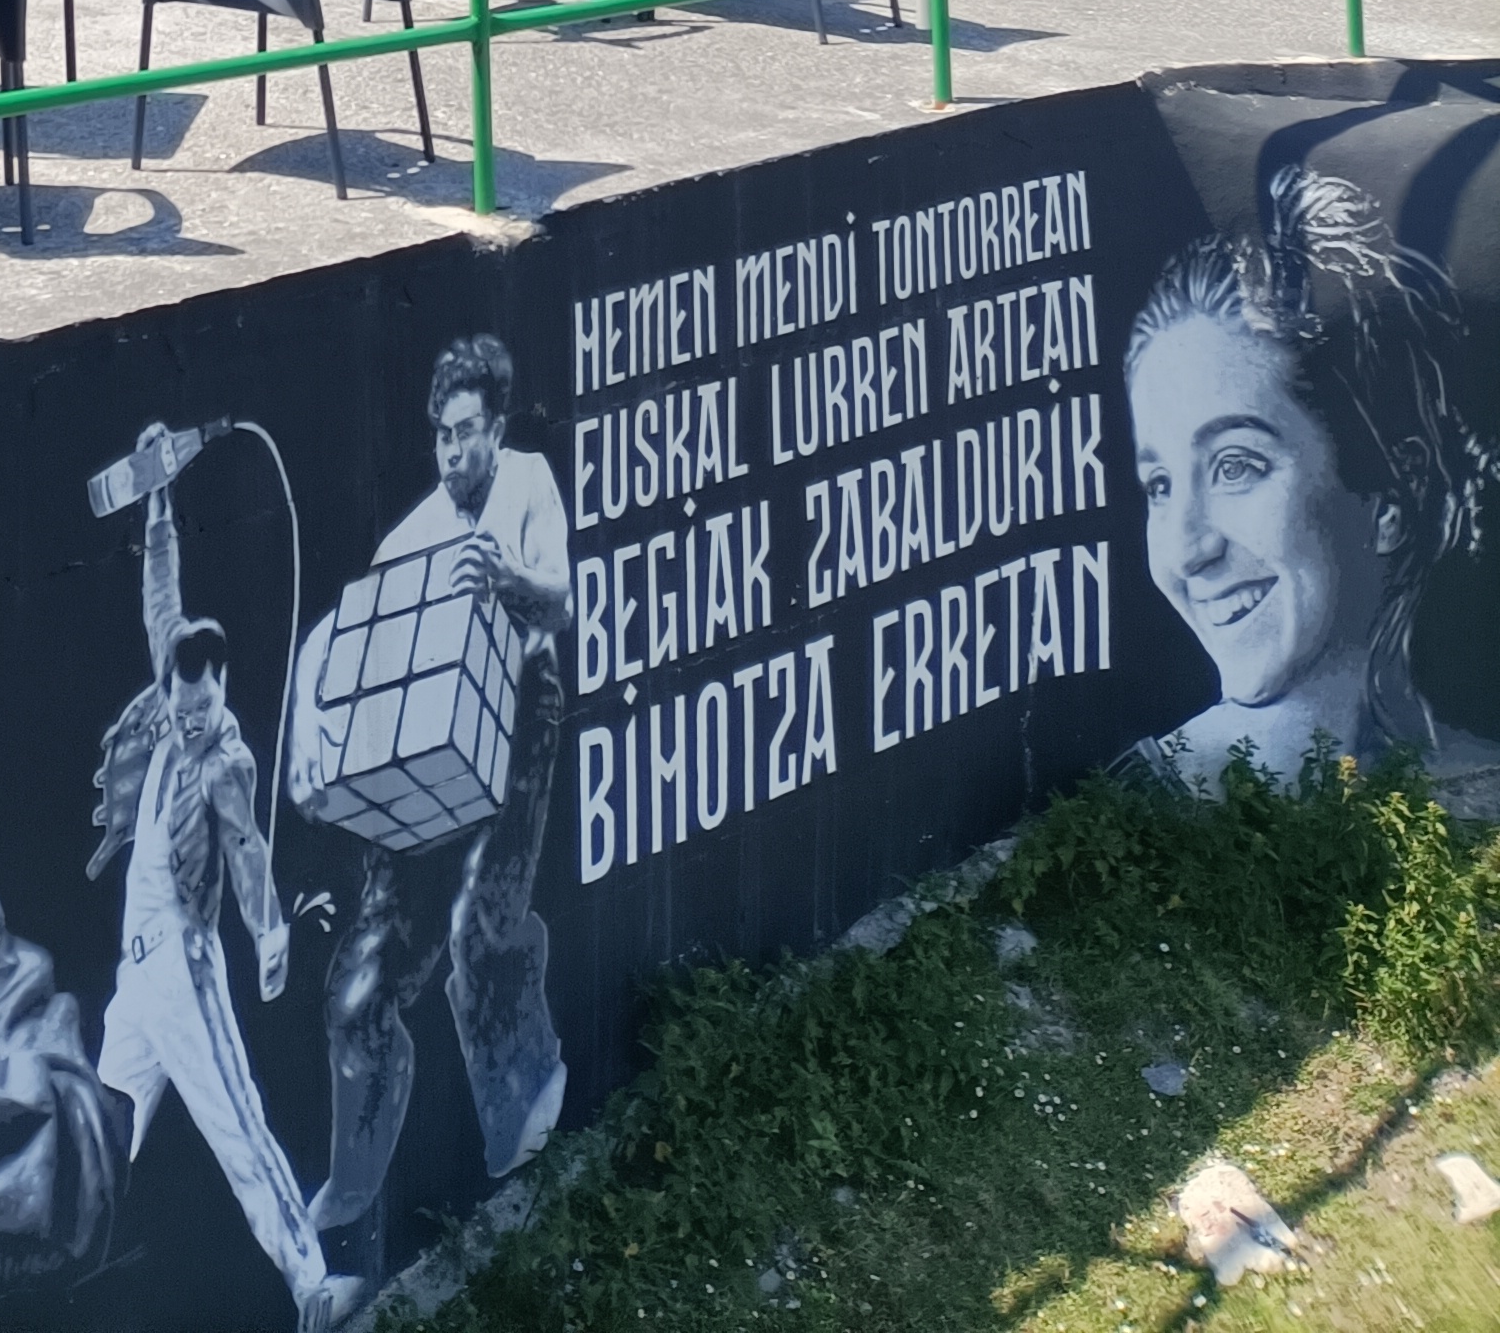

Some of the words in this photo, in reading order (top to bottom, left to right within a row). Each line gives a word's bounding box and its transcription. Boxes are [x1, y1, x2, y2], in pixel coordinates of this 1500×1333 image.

[575, 264, 717, 396] HEMEN
[735, 211, 857, 348] MENDI
[871, 170, 1092, 306] TONTORREAN
[575, 376, 749, 531] EUSKAL
[771, 318, 929, 465] LURREN
[947, 274, 1099, 405] ARTEAN
[576, 497, 772, 696] BEGIAK
[805, 378, 1107, 609] ZABALDURIK
[872, 540, 1111, 754] ERRETAN
